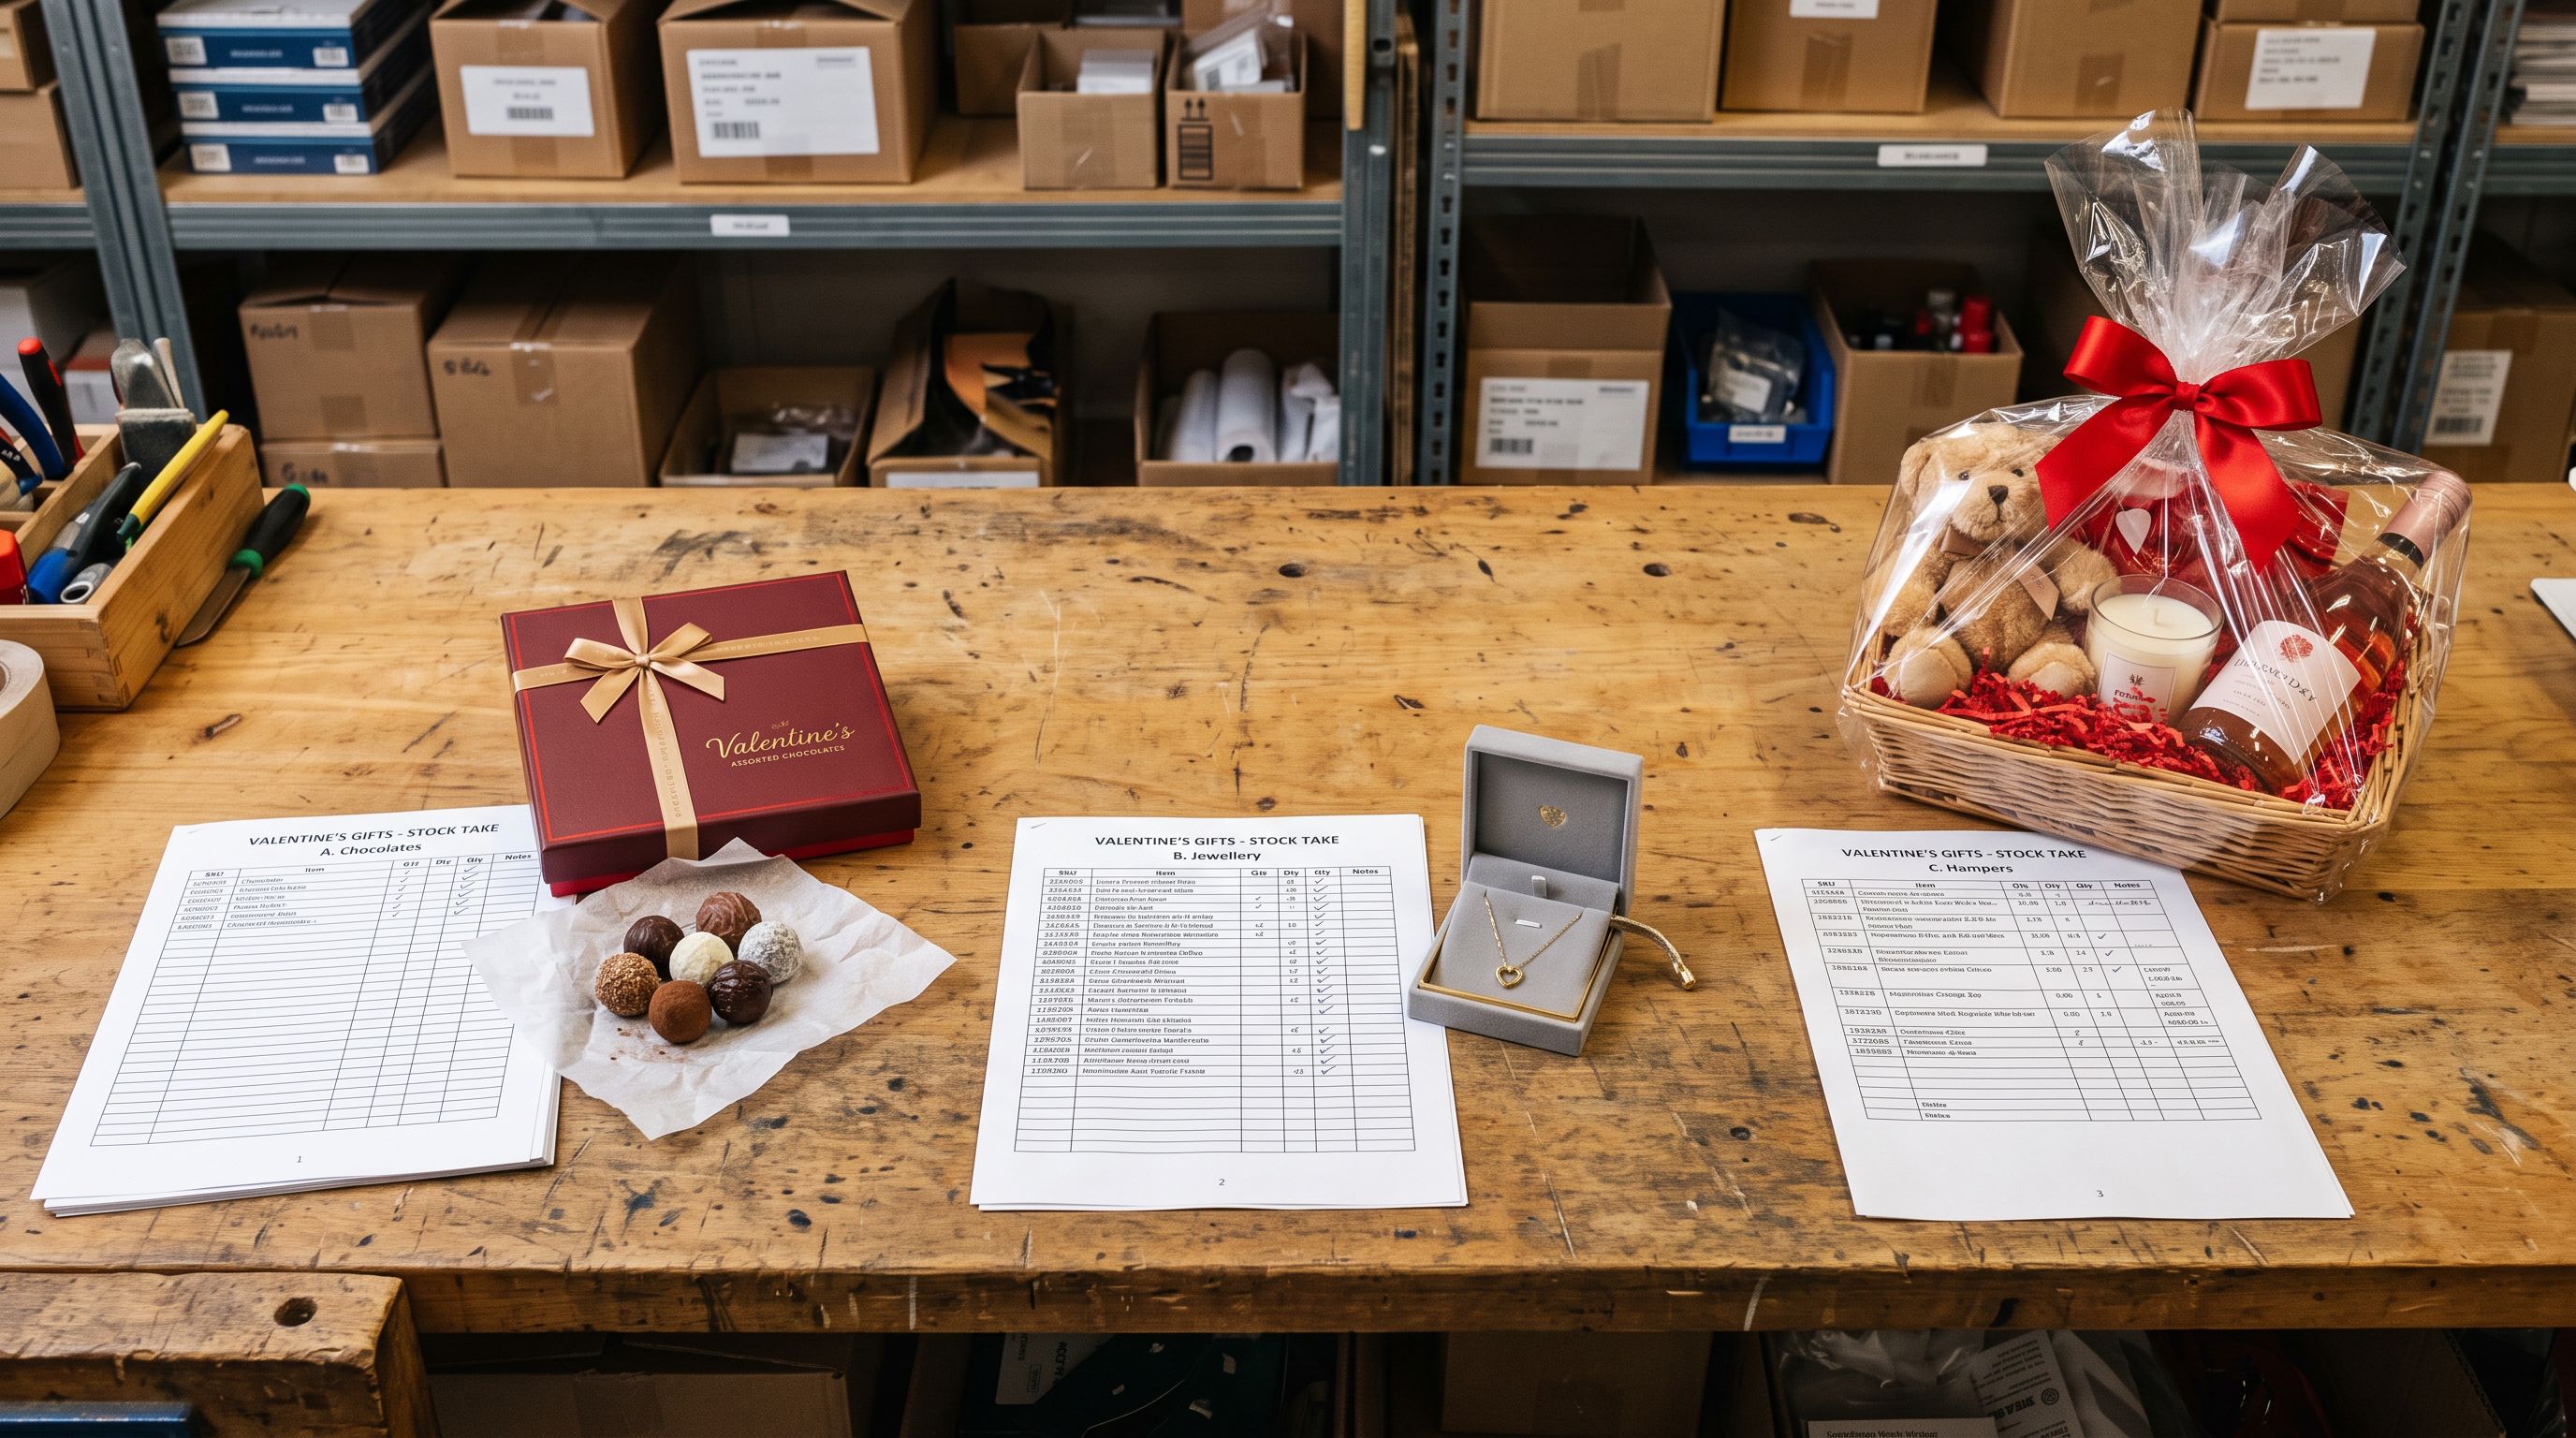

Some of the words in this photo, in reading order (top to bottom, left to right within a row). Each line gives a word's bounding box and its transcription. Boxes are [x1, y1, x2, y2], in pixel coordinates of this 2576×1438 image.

[705, 722, 856, 758] Valentine's
[731, 755, 780, 768] ASSORTED
[783, 745, 845, 759] CHOCOLATES
[249, 832, 347, 845] VALENTINE'S
[351, 830, 393, 842] GIFTS
[407, 826, 459, 838] STOCK
[461, 823, 500, 834] TAKE
[1095, 837, 1190, 845] VALENTINE'S
[1194, 837, 1236, 845] GIFTS
[1250, 836, 1297, 845] STOCK
[1302, 836, 1339, 844] TAKE
[320, 847, 334, 857] A.
[340, 843, 422, 856] Chocolates
[1842, 848, 1938, 858] VALENTINE'S
[1941, 849, 1983, 858] GIFTS
[1997, 849, 2045, 858] STOCK
[2047, 850, 2086, 858] TAKE
[1174, 852, 1187, 860] B.
[1191, 851, 1261, 861] Jewellery
[1929, 864, 1943, 873] C.
[1947, 864, 2013, 873] Hampers
[1219, 1178, 1225, 1186] 2
